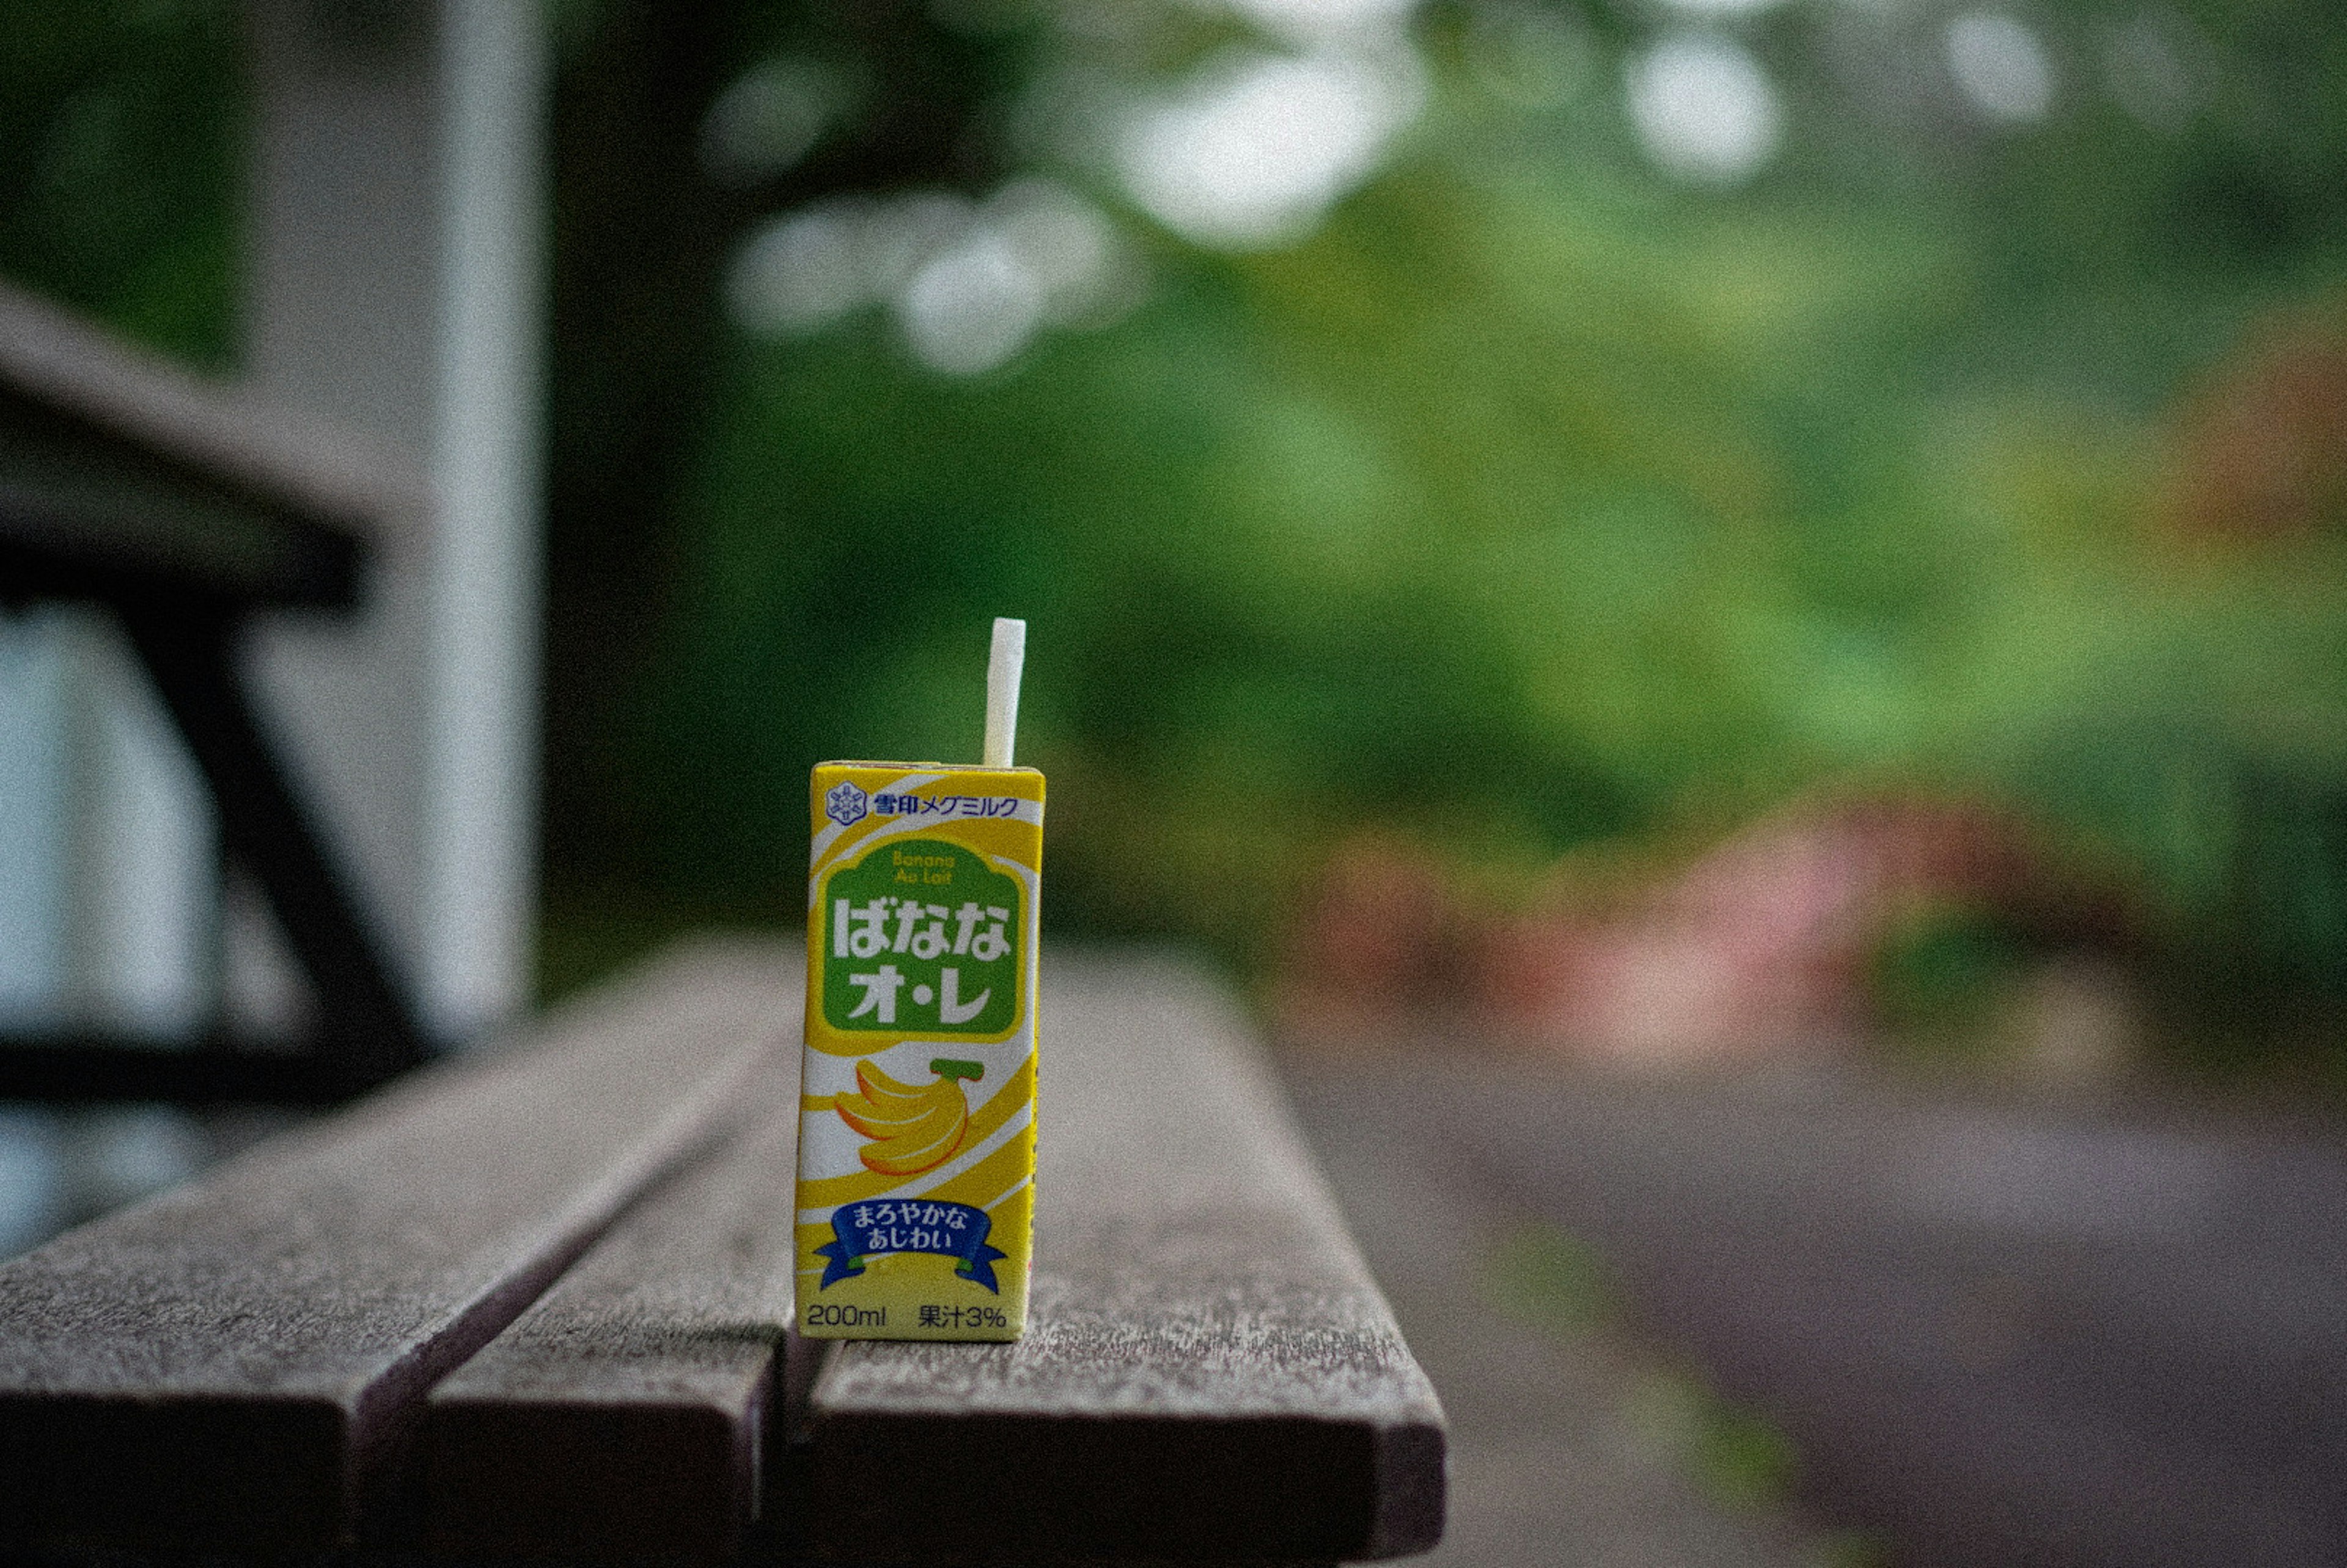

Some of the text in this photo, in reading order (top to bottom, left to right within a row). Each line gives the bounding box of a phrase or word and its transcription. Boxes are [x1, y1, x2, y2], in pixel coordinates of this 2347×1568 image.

[873, 795, 1019, 818] 雪印メグミルク
[892, 851, 955, 867] Banana
[923, 870, 953, 885] Lait
[834, 896, 1012, 962] ばなな
[848, 965, 991, 1024] オ・レ
[853, 1203, 969, 1230] まろやかな
[869, 1227, 952, 1249] あじわい
[807, 1305, 886, 1327] 200ml
[918, 1305, 1007, 1328] 果汁3%
